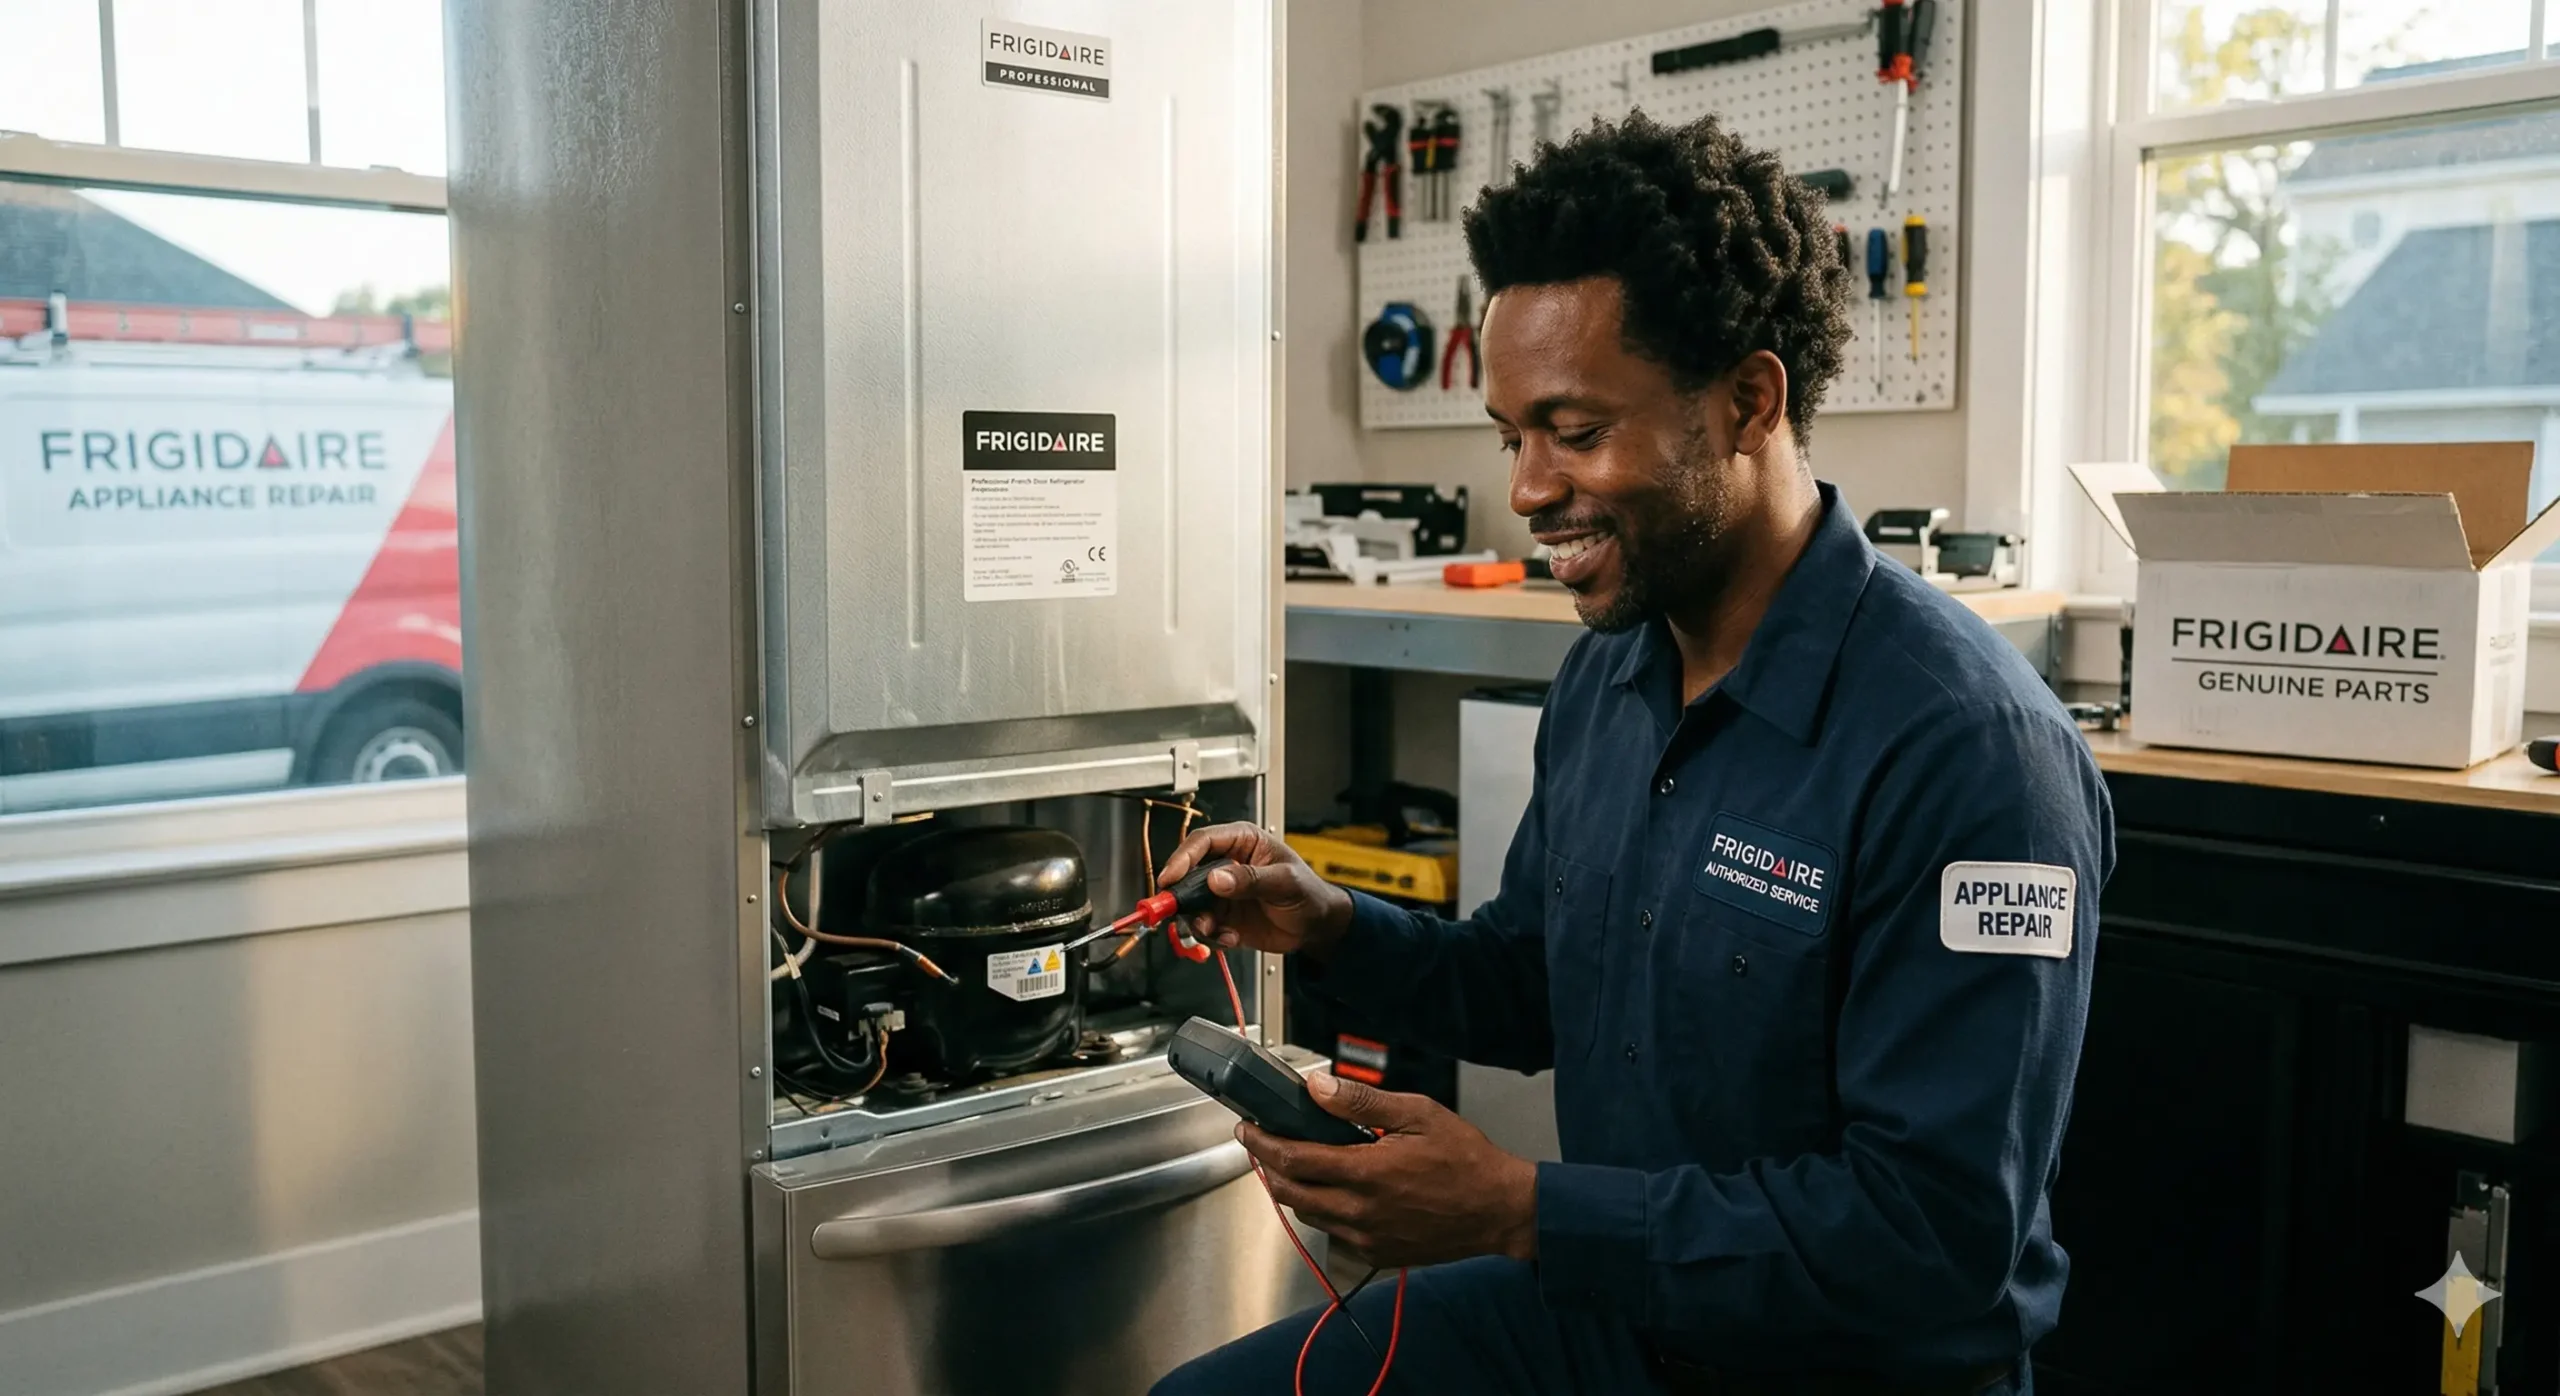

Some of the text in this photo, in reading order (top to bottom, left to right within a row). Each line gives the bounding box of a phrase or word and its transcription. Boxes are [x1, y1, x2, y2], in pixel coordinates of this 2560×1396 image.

[990, 32, 1104, 66] FRIGIDAIRE
[1000, 68, 1096, 91] PROFESSIONAL
[40, 431, 387, 472] FRIGIDAIRE
[976, 431, 1104, 452] FRIGIDAIRE
[68, 483, 378, 510] APPLIANCE REPAIR
[2172, 618, 2439, 660] FRIGIDAIRE
[2198, 671, 2430, 704] GENUINE PARTS
[1711, 833, 1825, 890] FRIGIDAIRE
[1704, 861, 1820, 913] AUTHORIZED SERVICE
[1954, 881, 2068, 910] APPLIANCE
[1978, 911, 2053, 938] REPAIR
